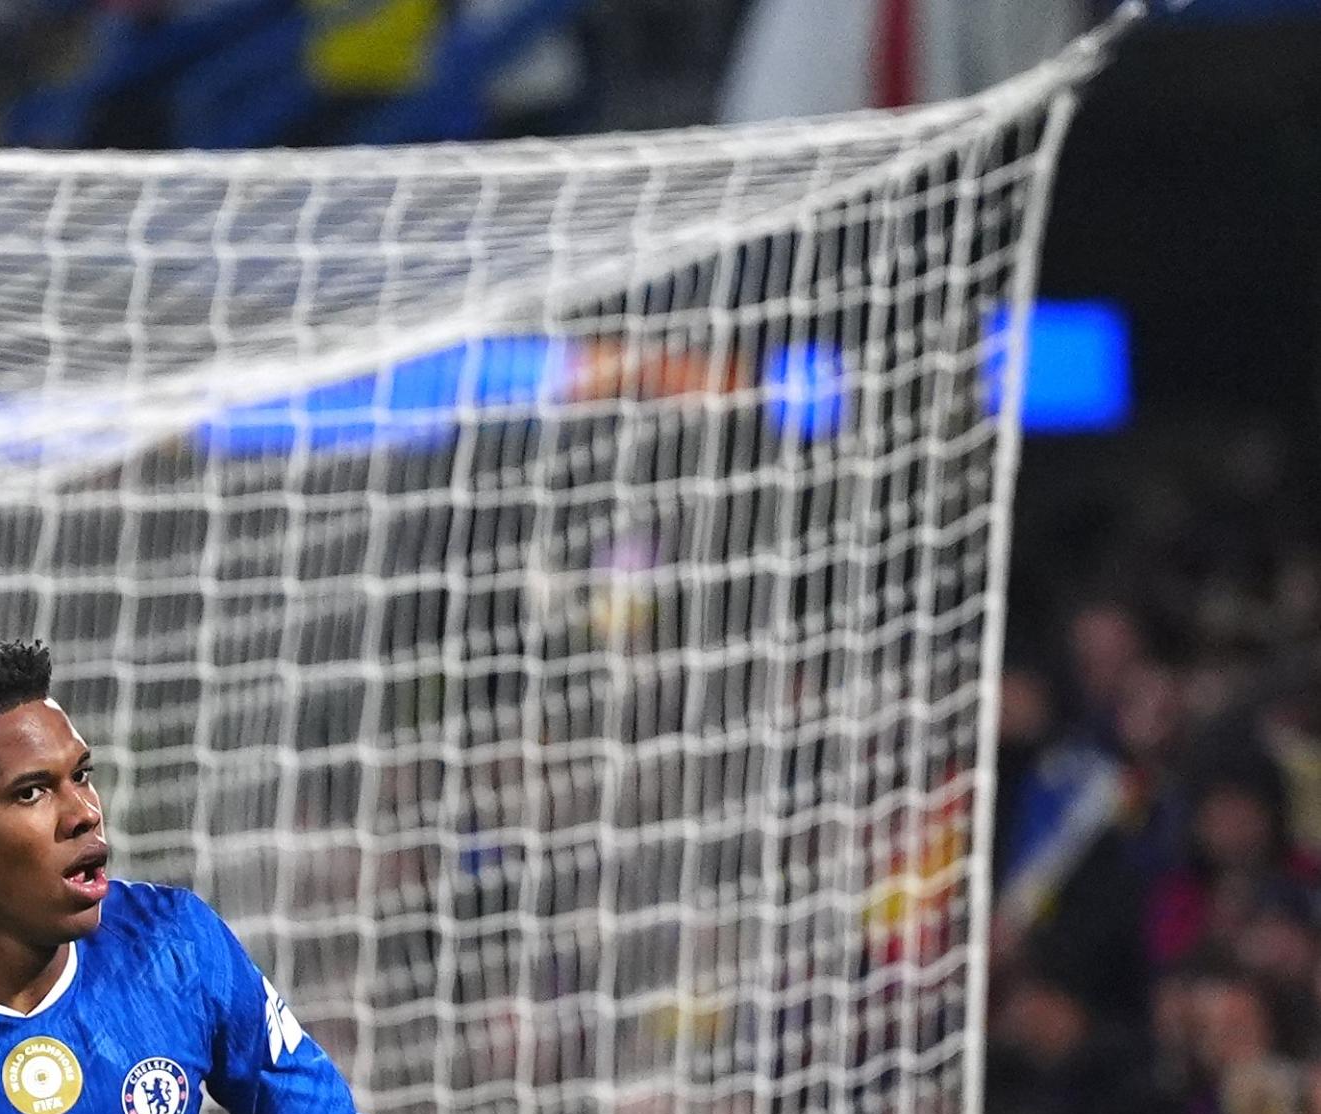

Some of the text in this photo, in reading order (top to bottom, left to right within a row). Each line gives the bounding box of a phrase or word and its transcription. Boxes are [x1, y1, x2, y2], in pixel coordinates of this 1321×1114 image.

[9, 1043, 75, 1093] WORLD CHAMPIONS
[129, 1061, 173, 1085] CHELSEA
[32, 1096, 63, 1113] FIFA
